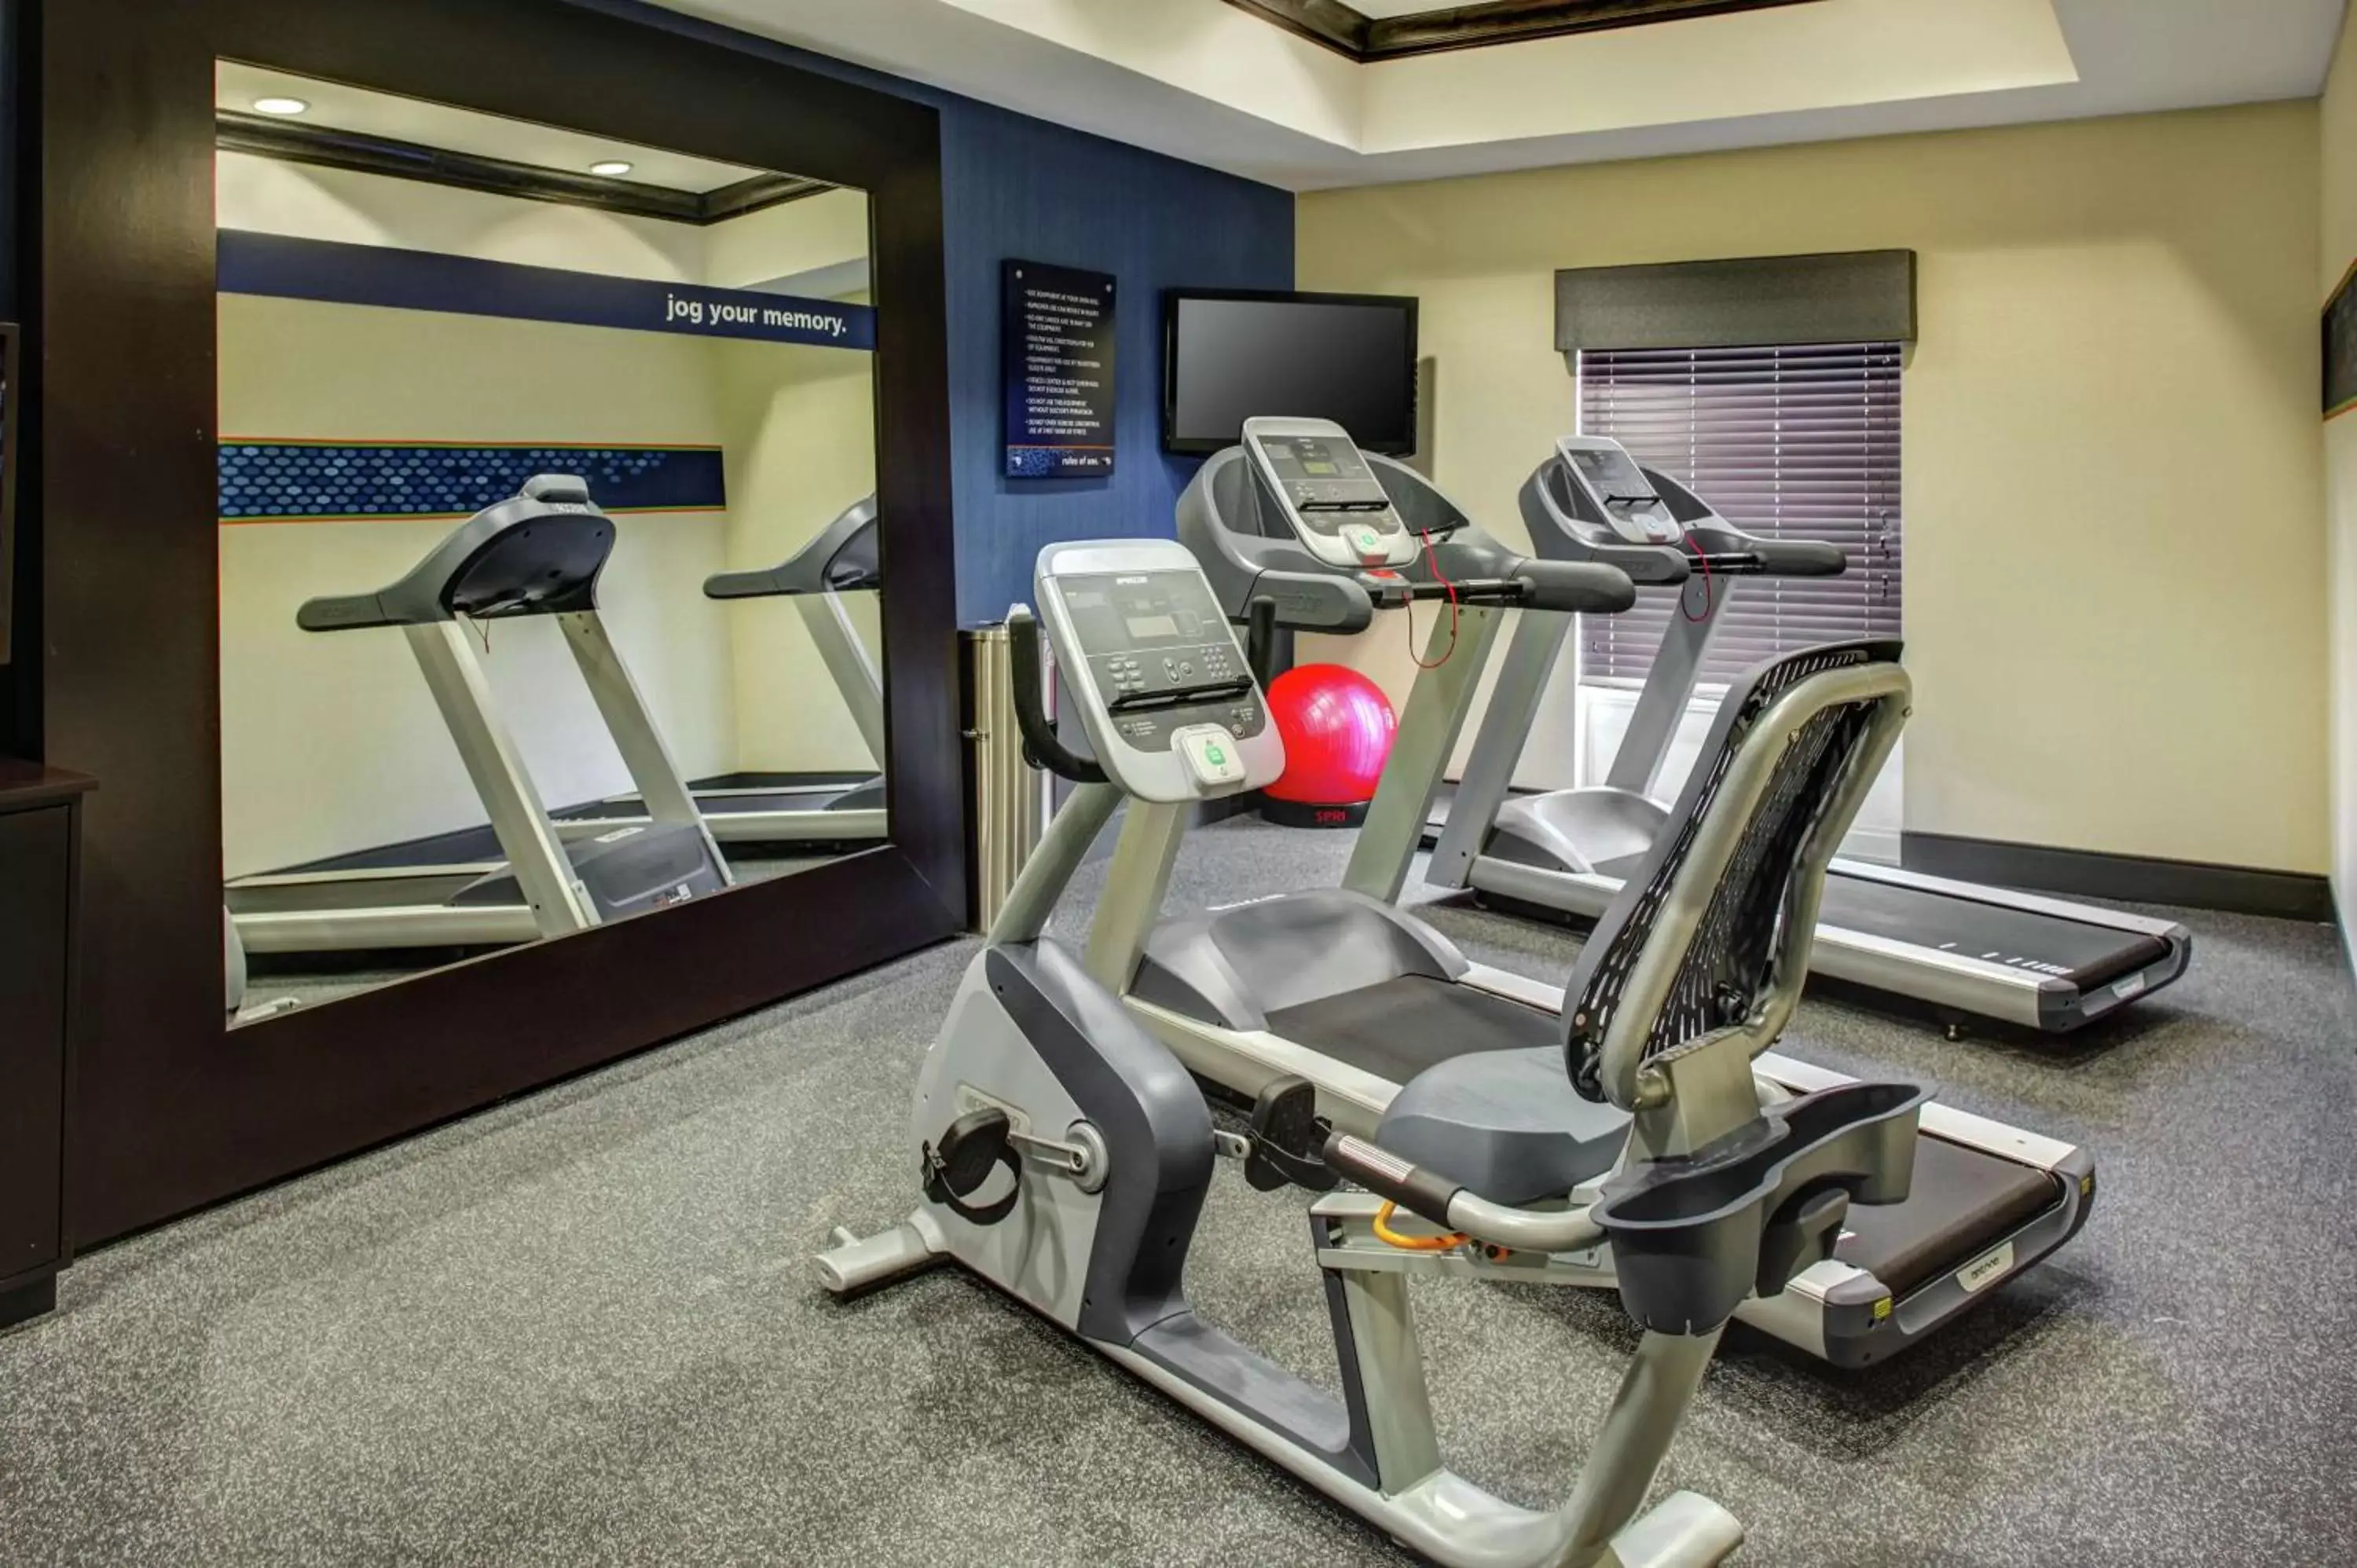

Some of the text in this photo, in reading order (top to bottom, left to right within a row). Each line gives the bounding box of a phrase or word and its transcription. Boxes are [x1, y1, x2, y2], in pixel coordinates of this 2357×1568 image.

[666, 293, 847, 337] jog your memory.
[1314, 810, 1346, 823] SPRI
